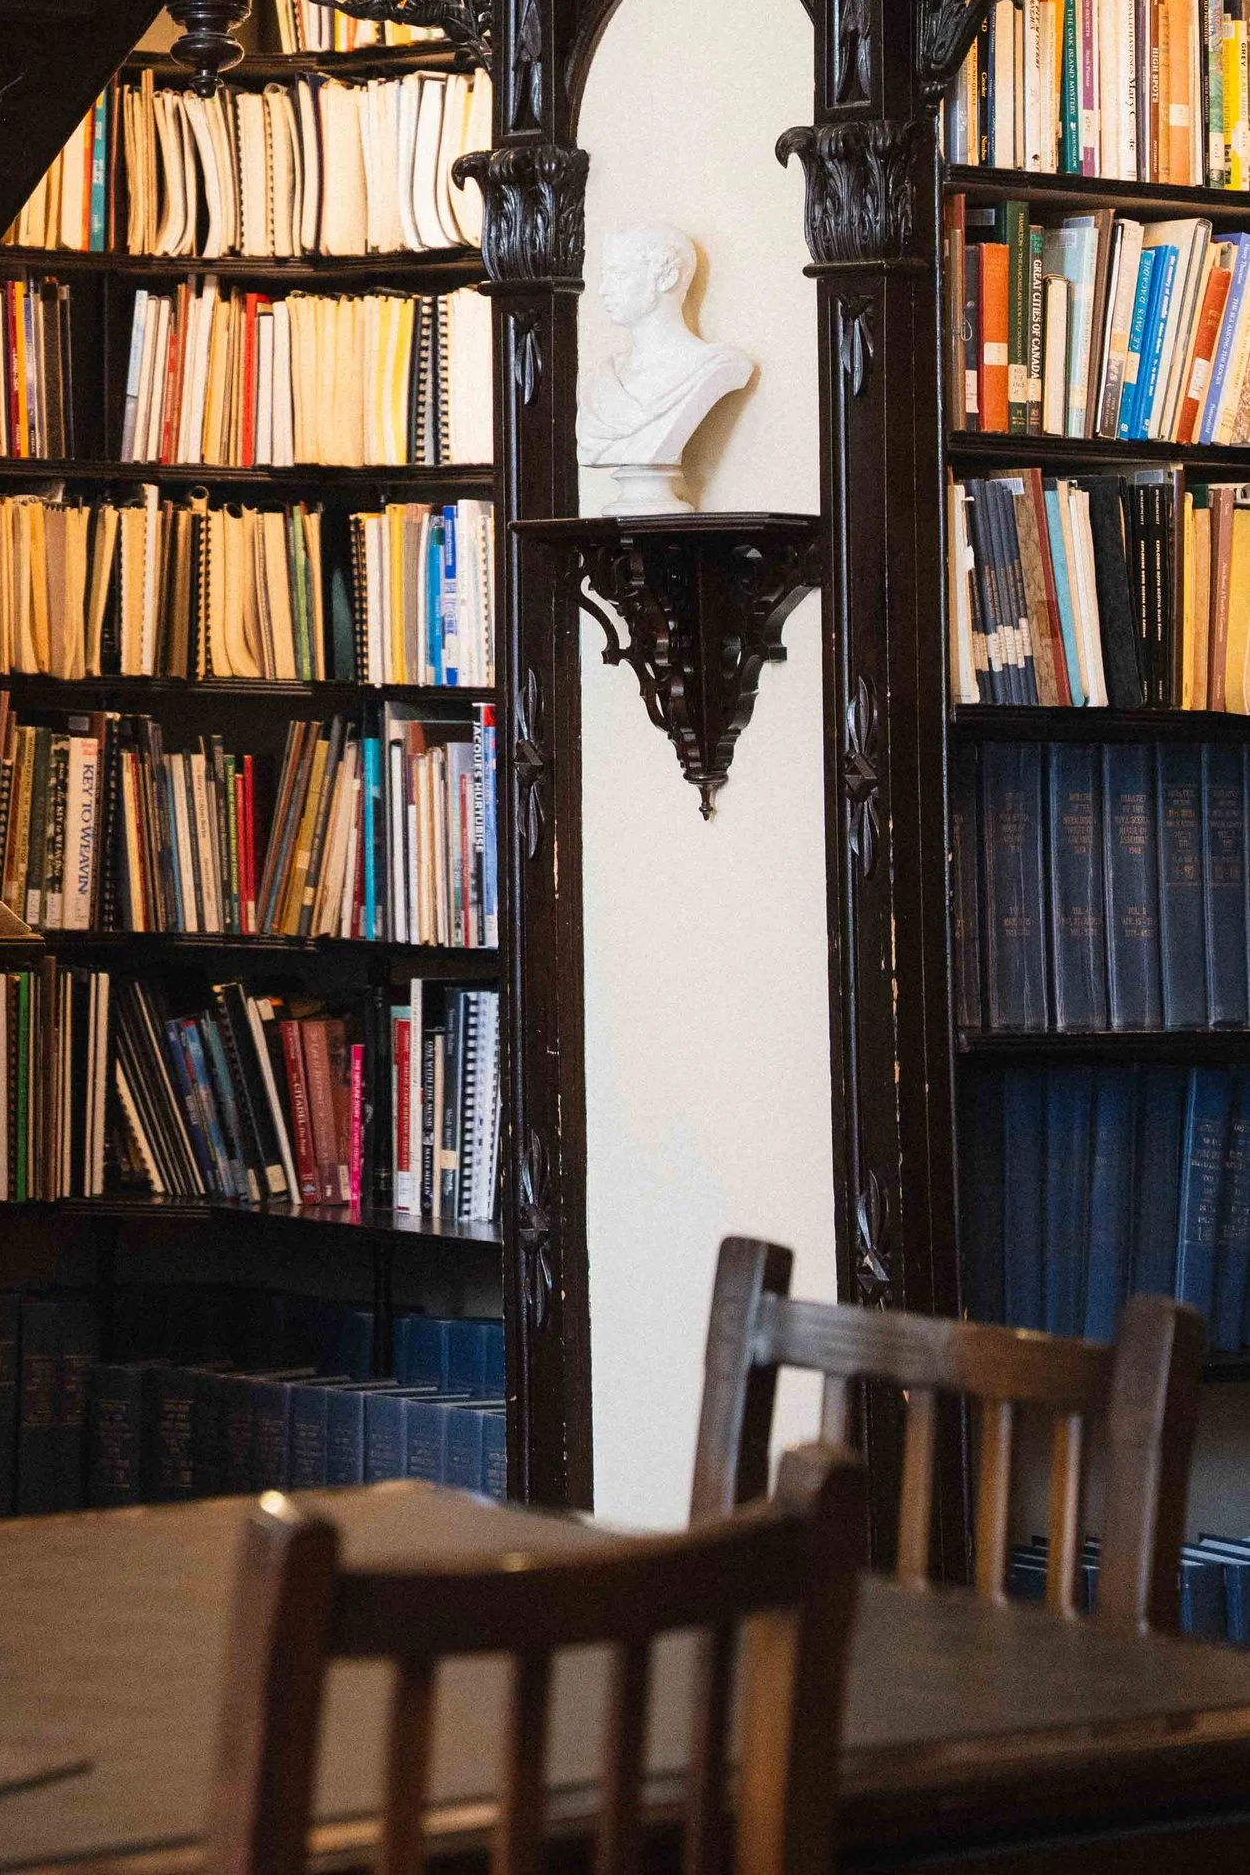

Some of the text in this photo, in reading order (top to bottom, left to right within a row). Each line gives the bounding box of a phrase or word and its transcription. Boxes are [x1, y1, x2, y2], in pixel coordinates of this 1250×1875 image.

[1067, 29, 1075, 45] OAK
[1068, 48, 1076, 78] ISLAND
[1126, 77, 1136, 108] Mary
[1133, 260, 1152, 350] LE PAYS D'ACADIE
[1229, 312, 1237, 324] SEA
[1231, 299, 1239, 311] THE
[1016, 318, 1023, 326] OF
[1032, 260, 1042, 379] GREAT CITIES OF CANADA
[1223, 325, 1234, 351] AMONG
[1220, 351, 1228, 364] THE
[1215, 364, 1225, 385] ROCKS
[473, 721, 485, 853] JACQUES HURTUBISE
[56, 806, 64, 822] KEY
[78, 765, 94, 896] KEY TO WEAVIN
[54, 835, 63, 877] WEAVING
[293, 1083, 306, 1125] CITADEL
